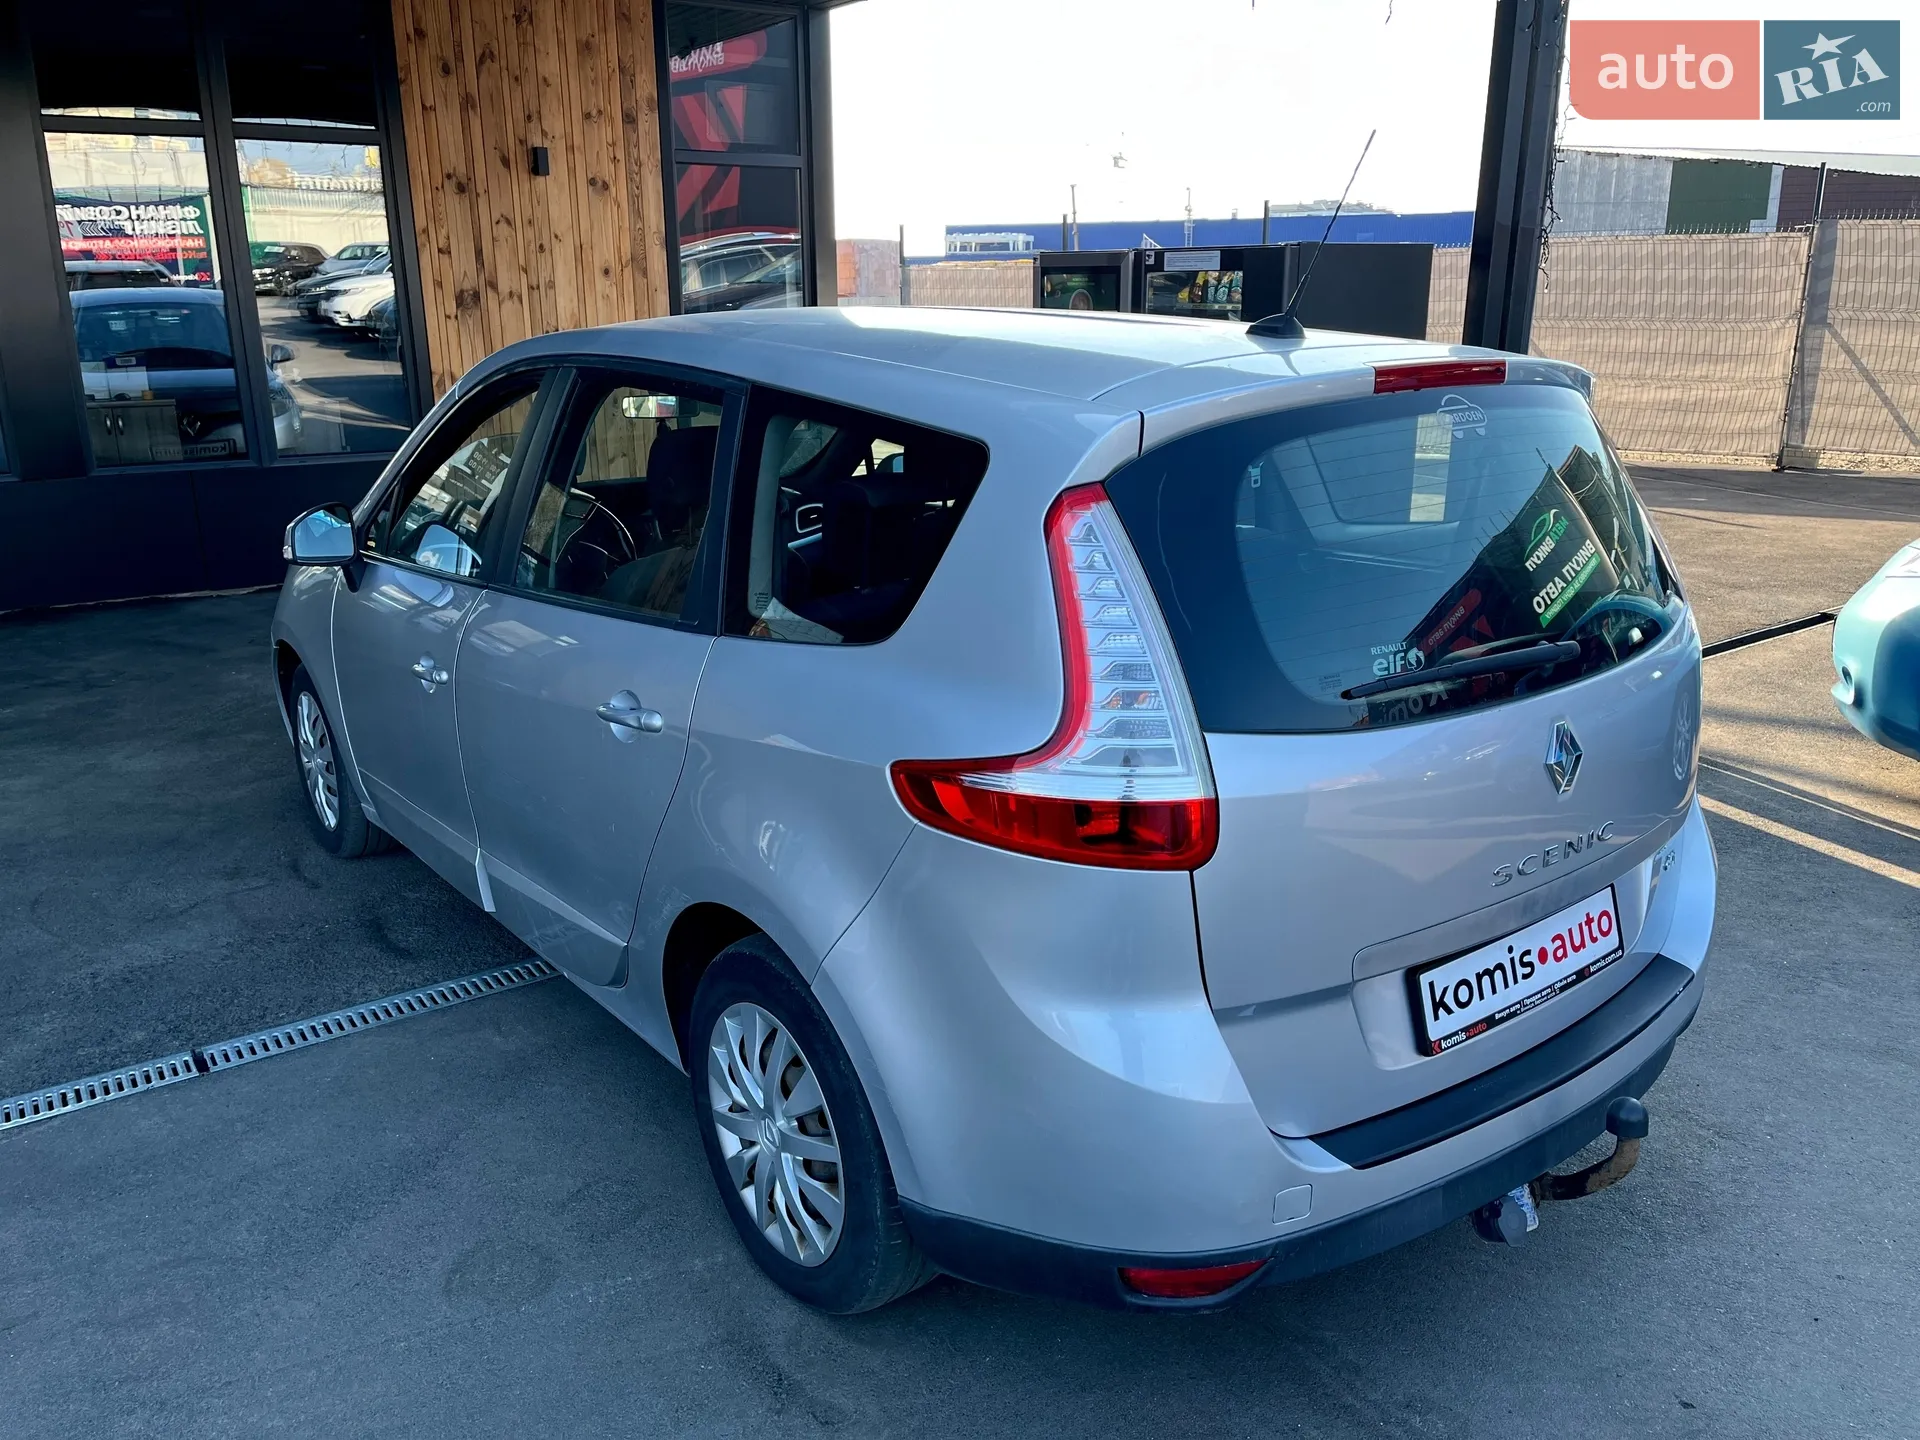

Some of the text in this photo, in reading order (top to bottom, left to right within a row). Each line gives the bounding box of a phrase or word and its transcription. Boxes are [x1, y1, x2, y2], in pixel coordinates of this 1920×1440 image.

[1370, 641, 1407, 656] RENAULT
[1372, 651, 1406, 677] elf
[1490, 820, 1615, 888] SCENIC
[1590, 949, 1623, 974] komis.com.ua
